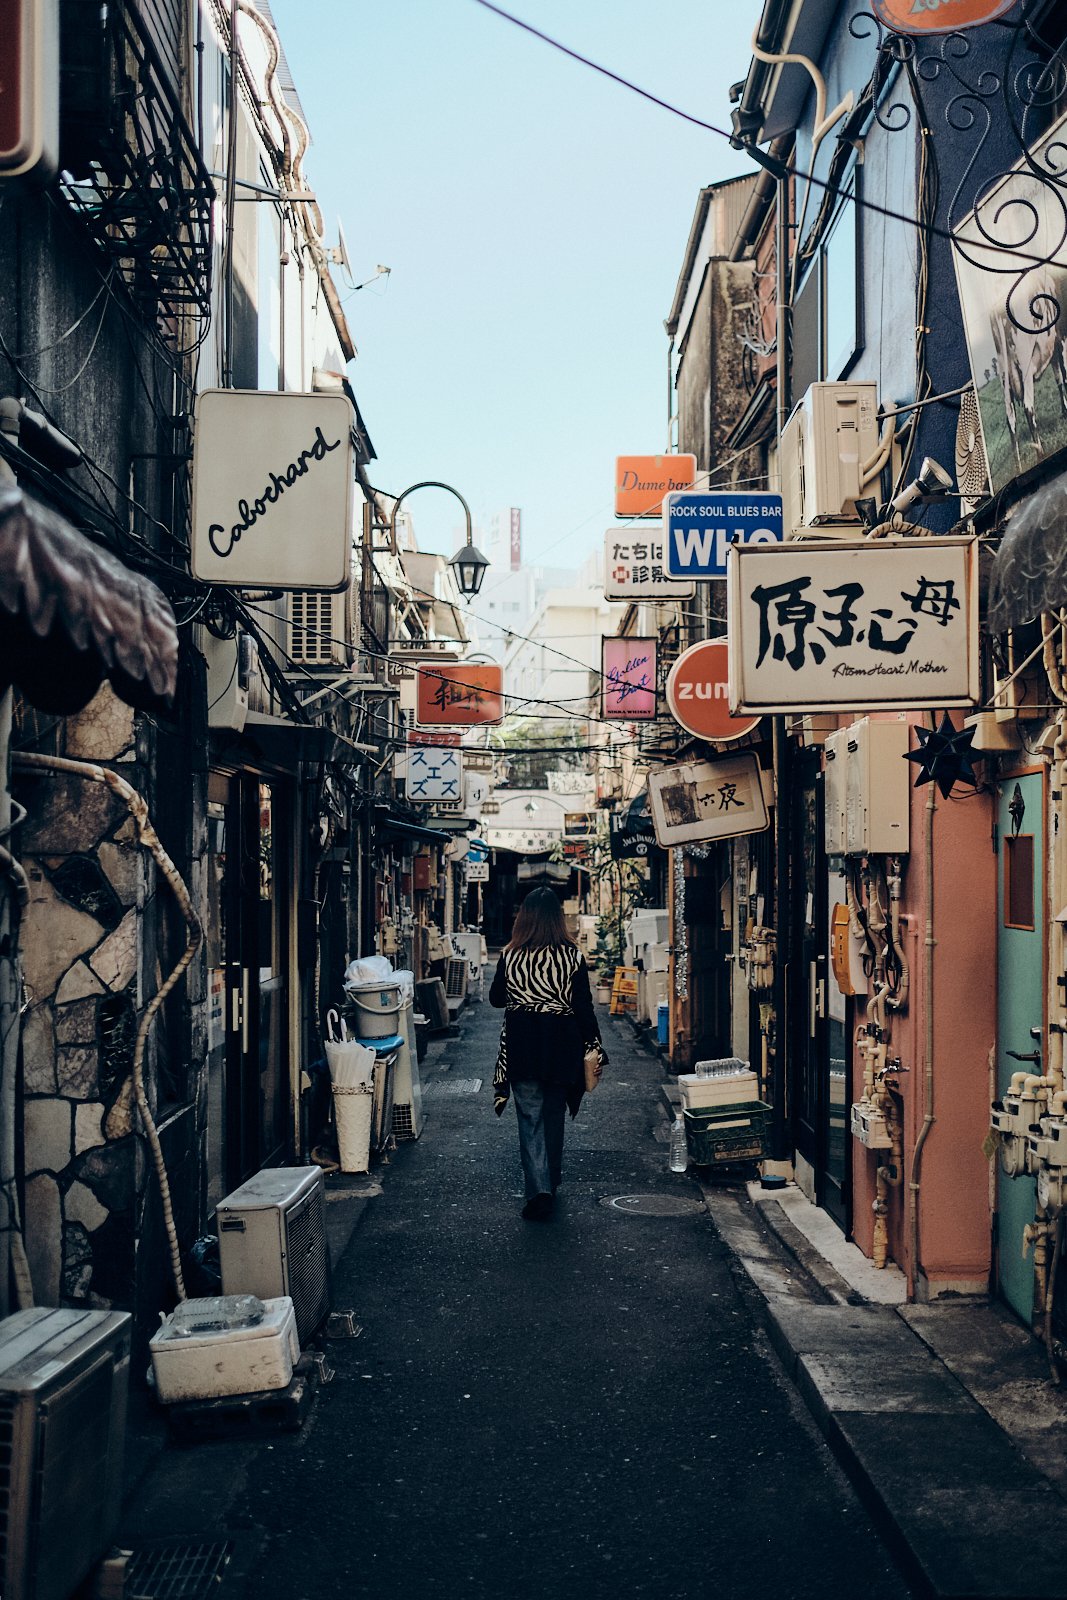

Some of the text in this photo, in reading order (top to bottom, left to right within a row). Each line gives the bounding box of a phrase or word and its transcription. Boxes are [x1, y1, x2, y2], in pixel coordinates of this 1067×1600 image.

[622, 471, 691, 491] Dume bar
[209, 426, 341, 557] Cabochard
[670, 506, 782, 516] ROCK SOUL BLUES BAR
[751, 576, 960, 671] 原子心母
[832, 660, 948, 678] Atom Heart Mother
[415, 735, 455, 745] スナック
